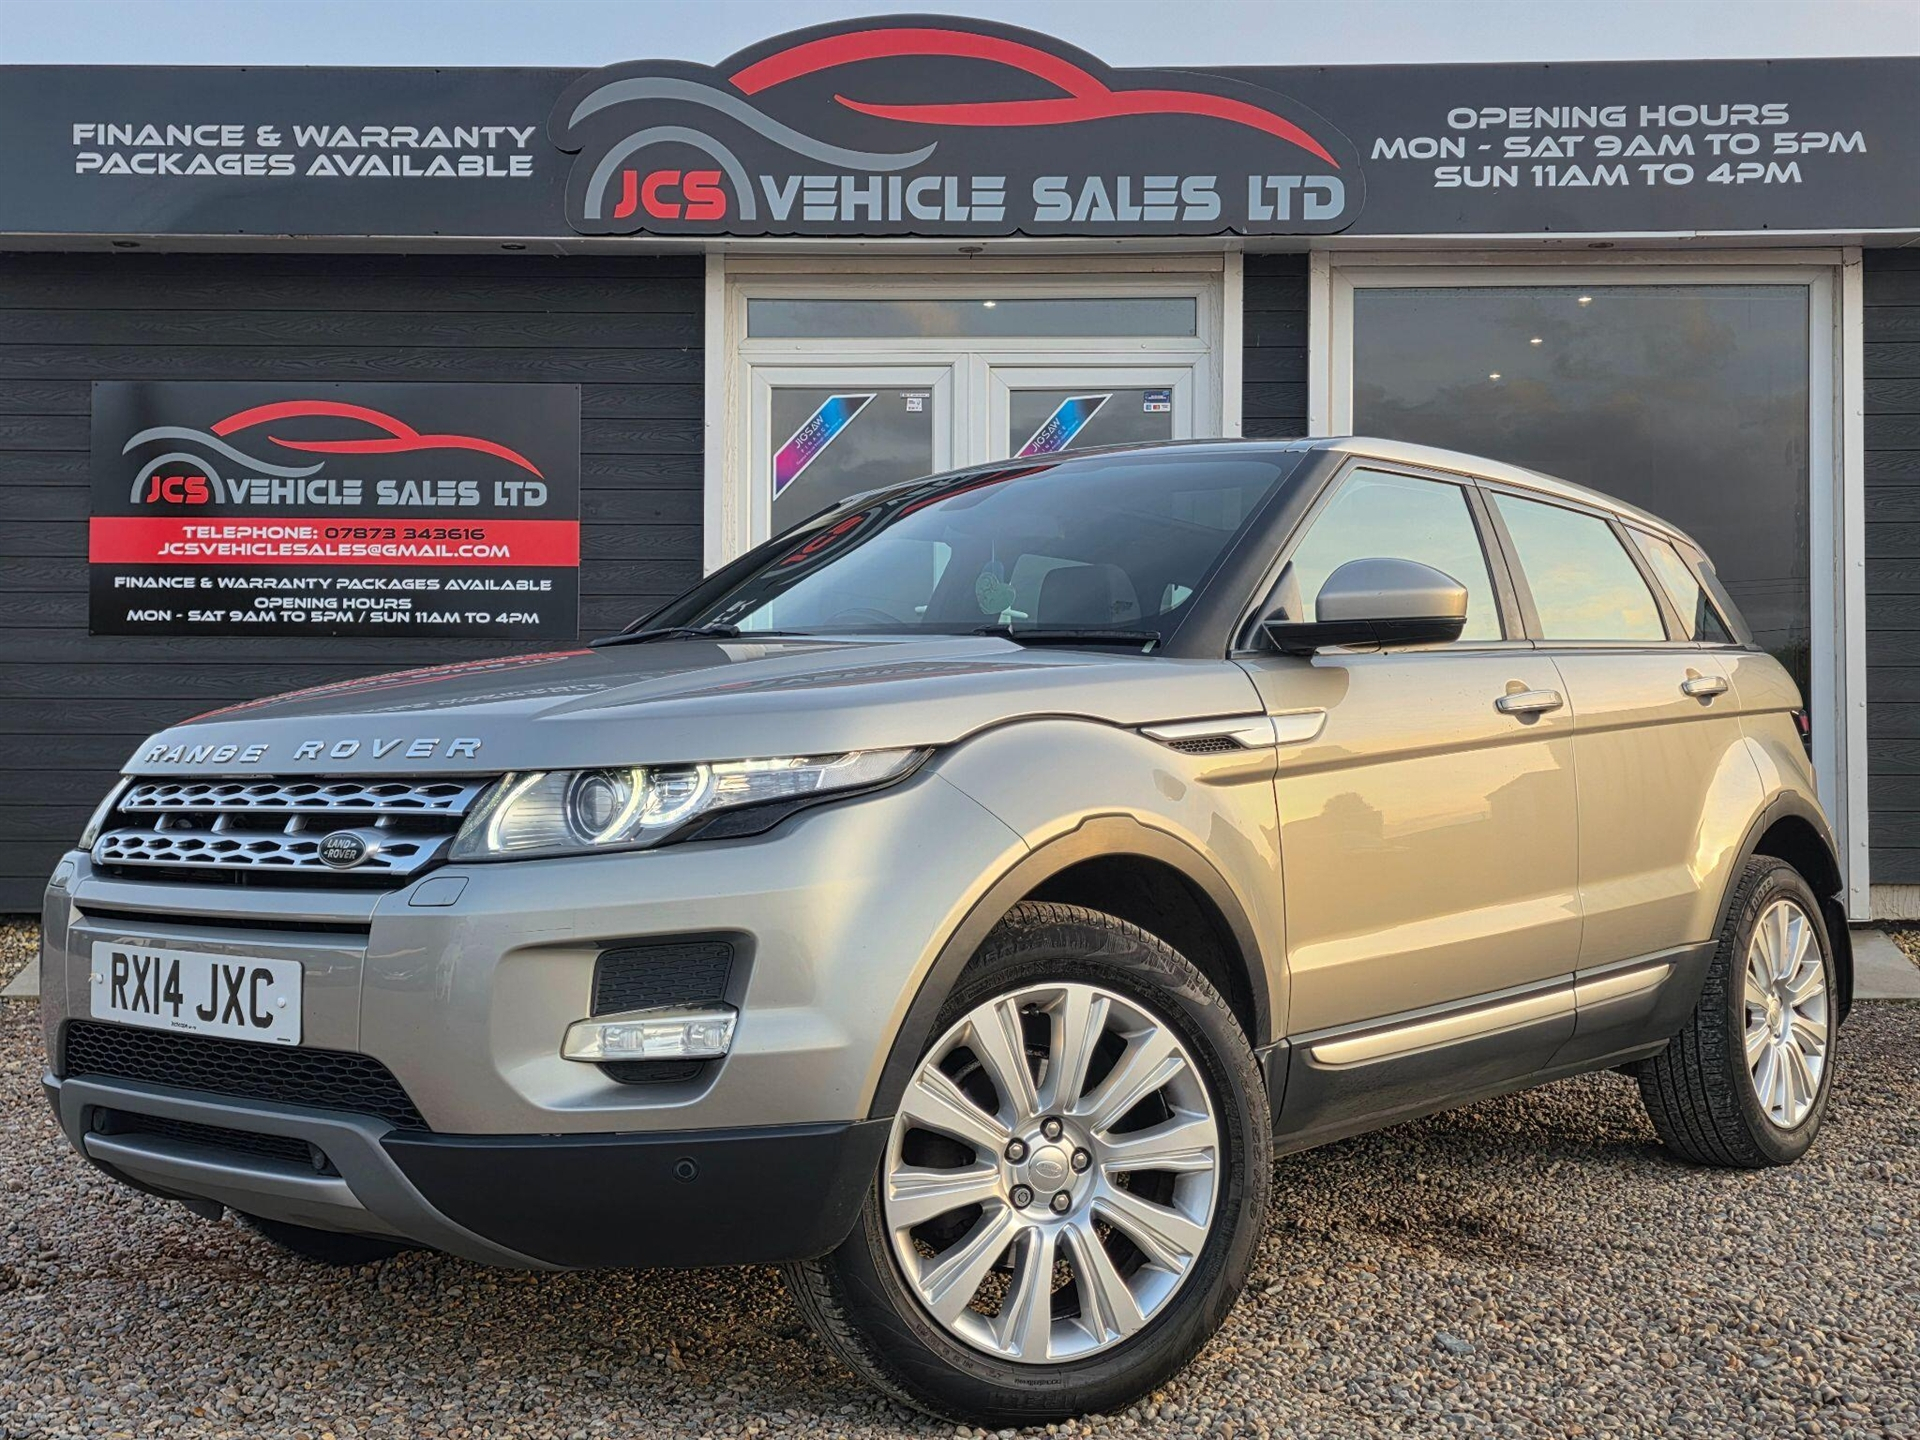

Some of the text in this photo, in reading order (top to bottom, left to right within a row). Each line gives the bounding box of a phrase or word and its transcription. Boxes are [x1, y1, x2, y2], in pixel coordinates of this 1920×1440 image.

[1448, 104, 1789, 129] OPENING HOURS
[73, 124, 535, 148] FINANCE & WARRANTY
[1371, 137, 1465, 159] MON
[1504, 136, 1585, 157] SAT
[1595, 134, 1695, 156] 9AM
[1704, 133, 1760, 155] TO
[1774, 131, 1866, 154] 5PM
[76, 153, 533, 176] PACKAGES AVAILABLE
[1434, 162, 1802, 187] SUN 11AM TO 4PM
[614, 170, 1344, 221] JCS VEHICLE SALES LTD
[795, 414, 824, 449] JIGSAW
[801, 423, 831, 454] FINANCE
[1032, 417, 1061, 452] JIGSAW
[147, 476, 547, 506] JCS VEHICLE SALES LTD
[183, 527, 485, 540] TELEPHONE: 07873 343616
[158, 543, 509, 557] JCSVEHICLESALES@GMAIL.COM
[115, 577, 551, 590] FINANCE & WARRANTY PACKAGES AVAILABLE
[254, 598, 411, 609] OPENING HOURS
[127, 610, 171, 621] MON
[188, 611, 225, 621] SAT
[230, 611, 276, 621] 9AM
[280, 611, 305, 622] TO
[311, 611, 354, 622] 5PM
[370, 612, 409, 622] SUN
[415, 612, 460, 623] 11AM
[465, 613, 490, 623] TO
[496, 613, 539, 623] 4PM
[144, 737, 483, 763] RANGE ROVER
[327, 839, 351, 849] LAND
[327, 848, 357, 859] ROVER
[112, 952, 274, 1028] RX14 JXC
